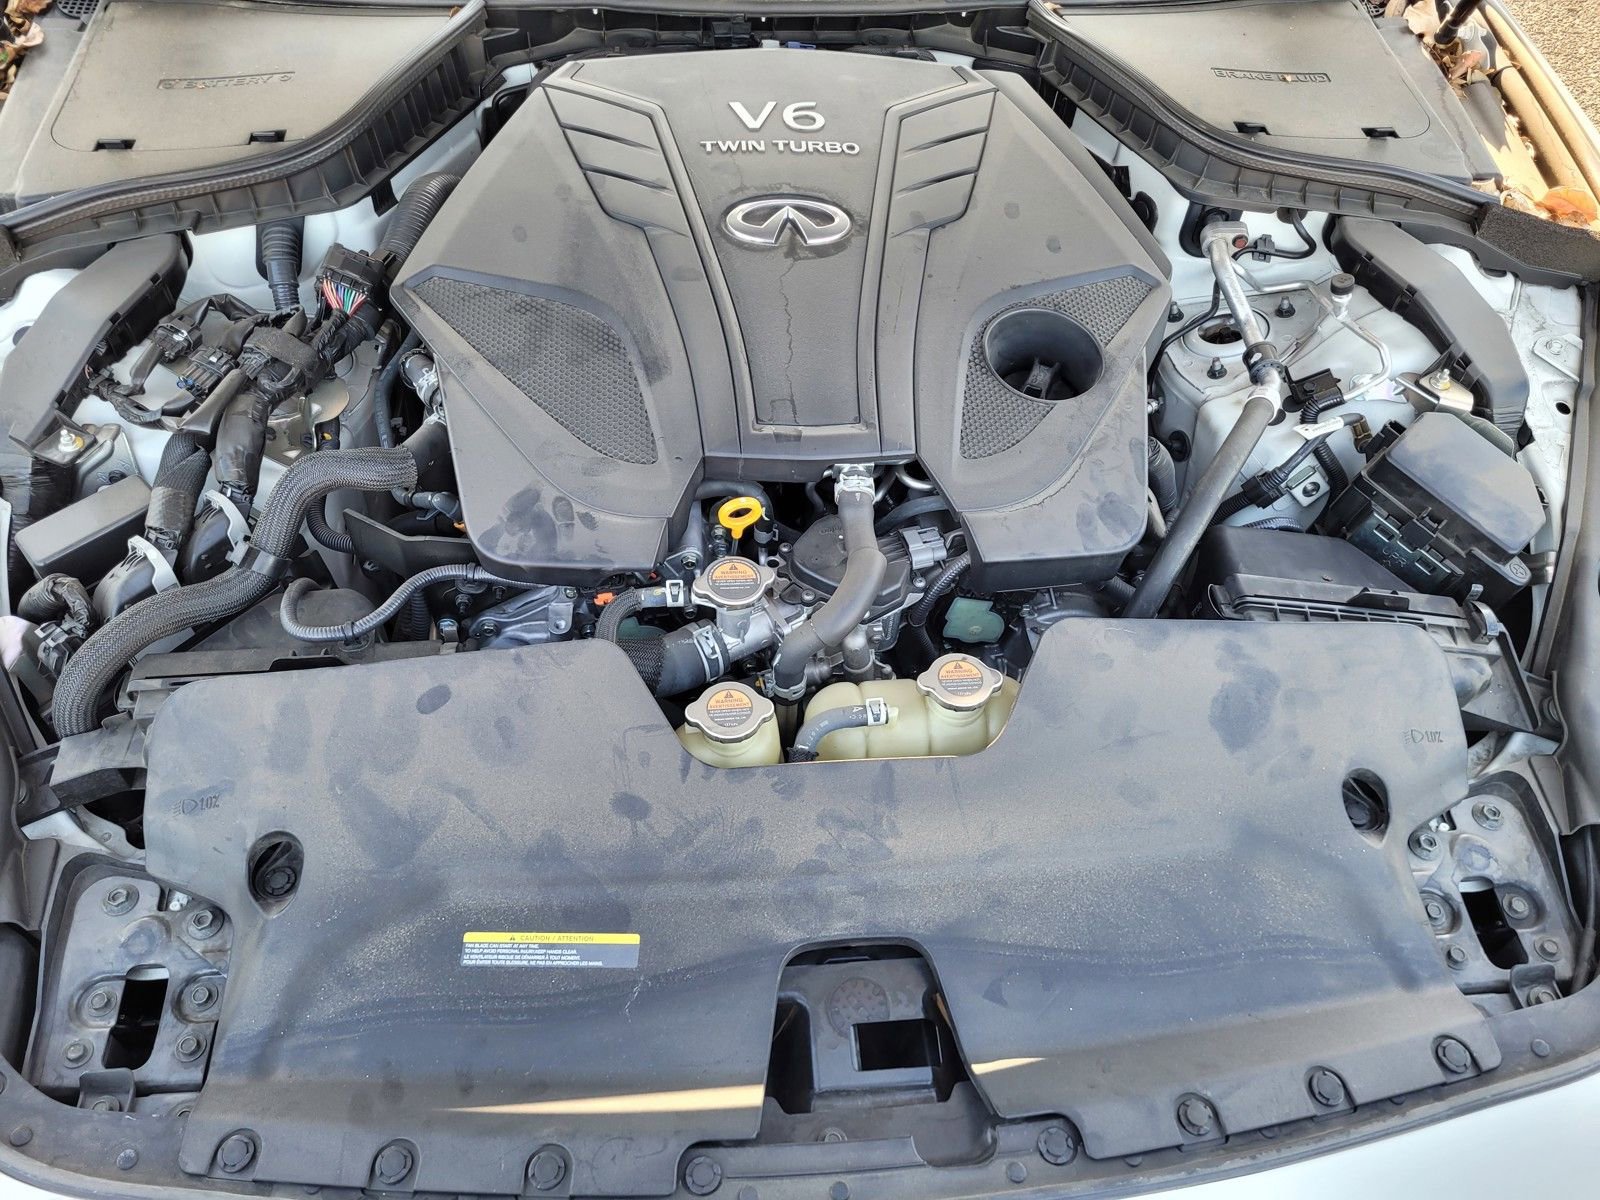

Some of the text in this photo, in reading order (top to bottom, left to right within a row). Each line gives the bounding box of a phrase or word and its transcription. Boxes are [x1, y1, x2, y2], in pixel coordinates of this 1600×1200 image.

[1213, 69, 1275, 82] BRAKE
[728, 101, 826, 133] V6
[700, 139, 861, 155] TWIN TURBO
